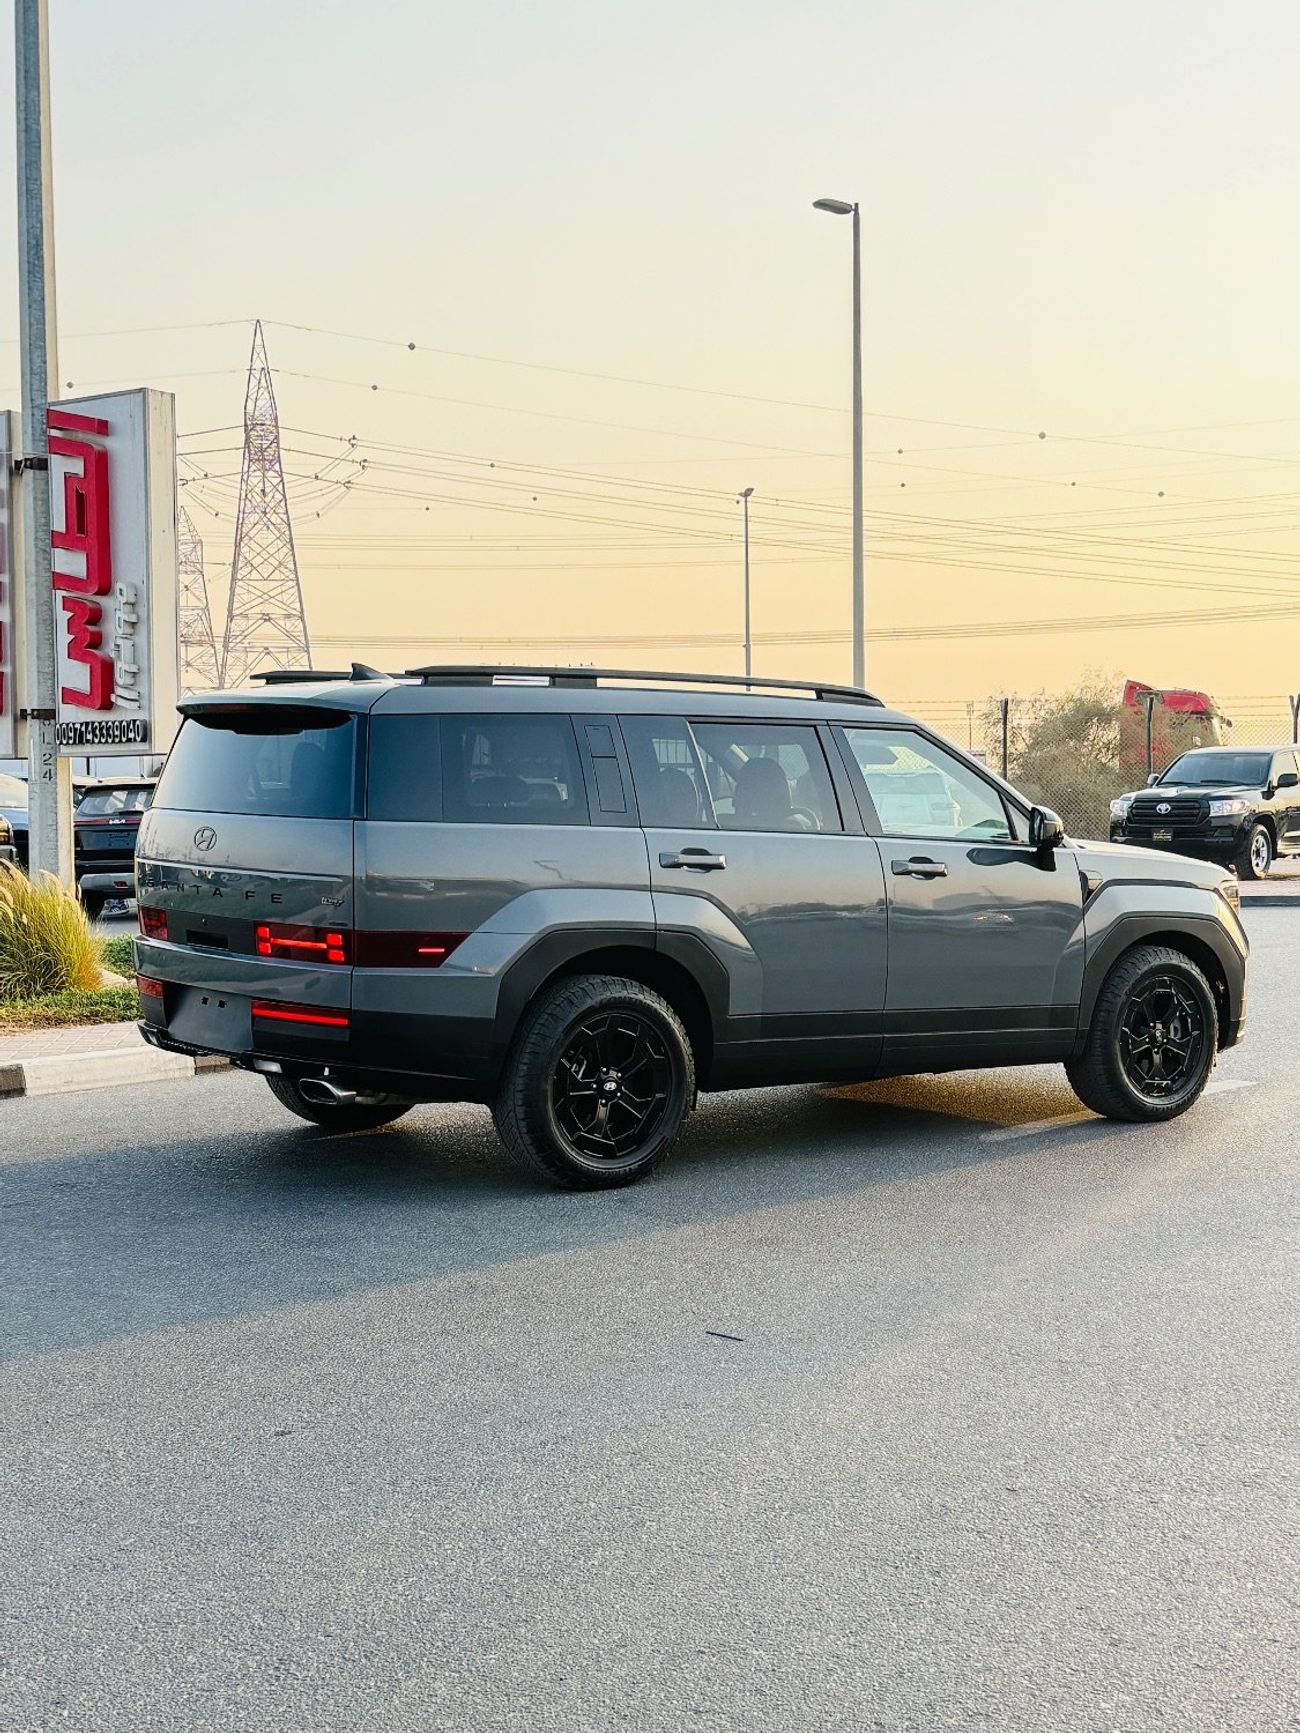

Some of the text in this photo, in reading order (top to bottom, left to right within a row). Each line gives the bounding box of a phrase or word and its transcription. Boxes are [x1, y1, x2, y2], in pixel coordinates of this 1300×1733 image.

[55, 719, 141, 745] 0097143339040
[146, 877, 283, 904] SANTA FE
